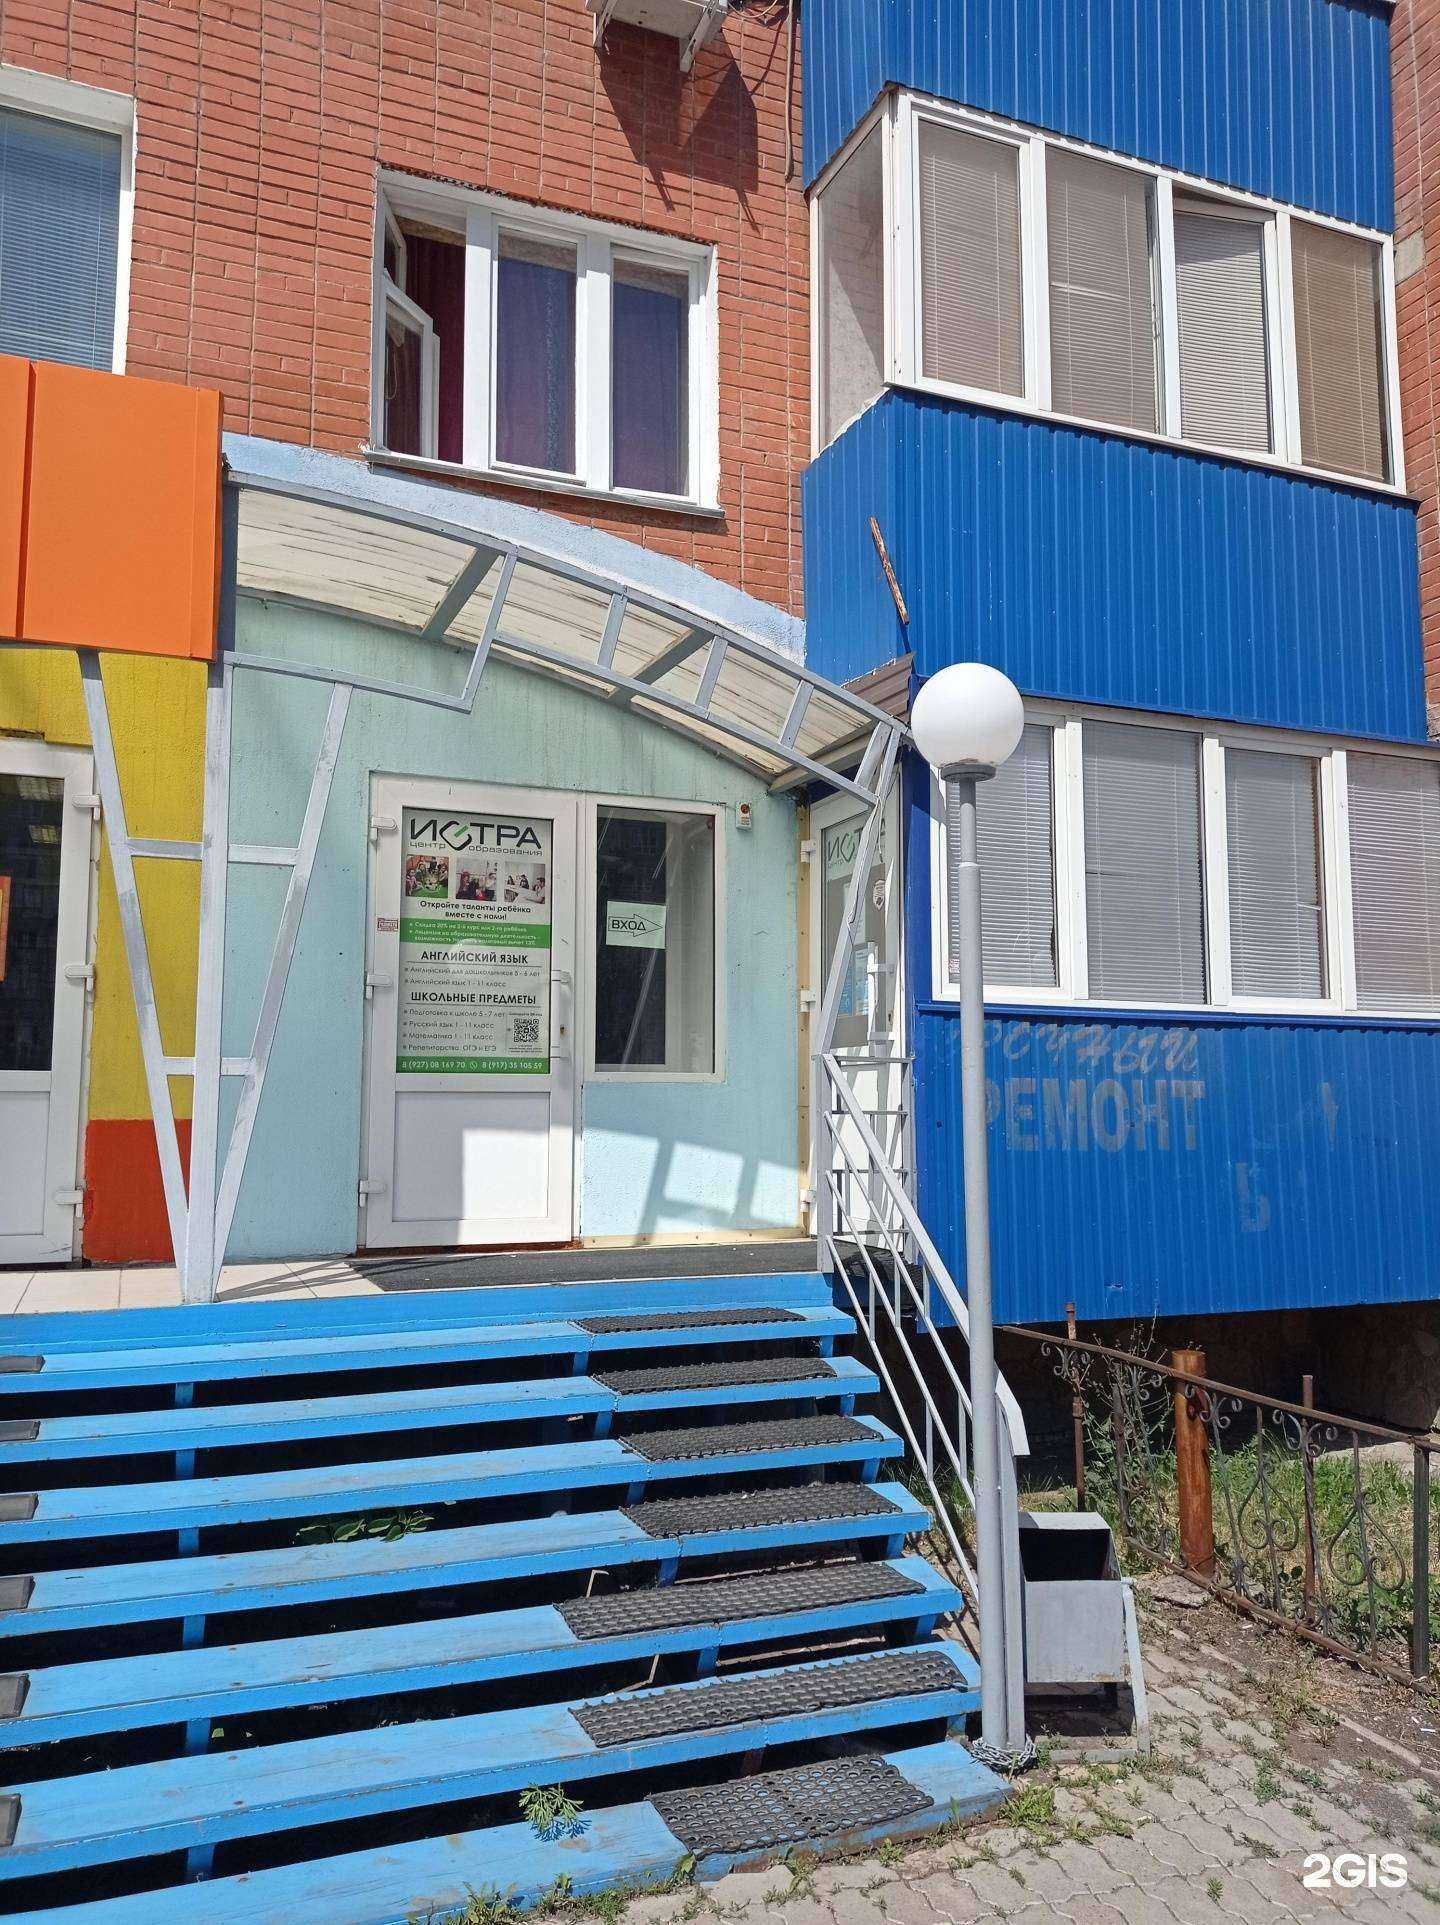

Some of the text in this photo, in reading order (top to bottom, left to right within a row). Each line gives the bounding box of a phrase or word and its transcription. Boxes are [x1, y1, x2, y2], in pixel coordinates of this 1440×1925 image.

[410, 819, 542, 851] ИСТРА
[407, 841, 543, 857] центр образования
[420, 900, 532, 913] Откройте таланты ребёнка
[445, 911, 475, 919] вместе
[611, 919, 646, 931] ВХОД
[420, 951, 528, 964] АНГЛИЙСКИЙ ЯЗЫК
[411, 991, 536, 1005] ШКОЛЬНЫЕ ПРЕДМЕТЫ
[408, 1060, 429, 1070] (927)
